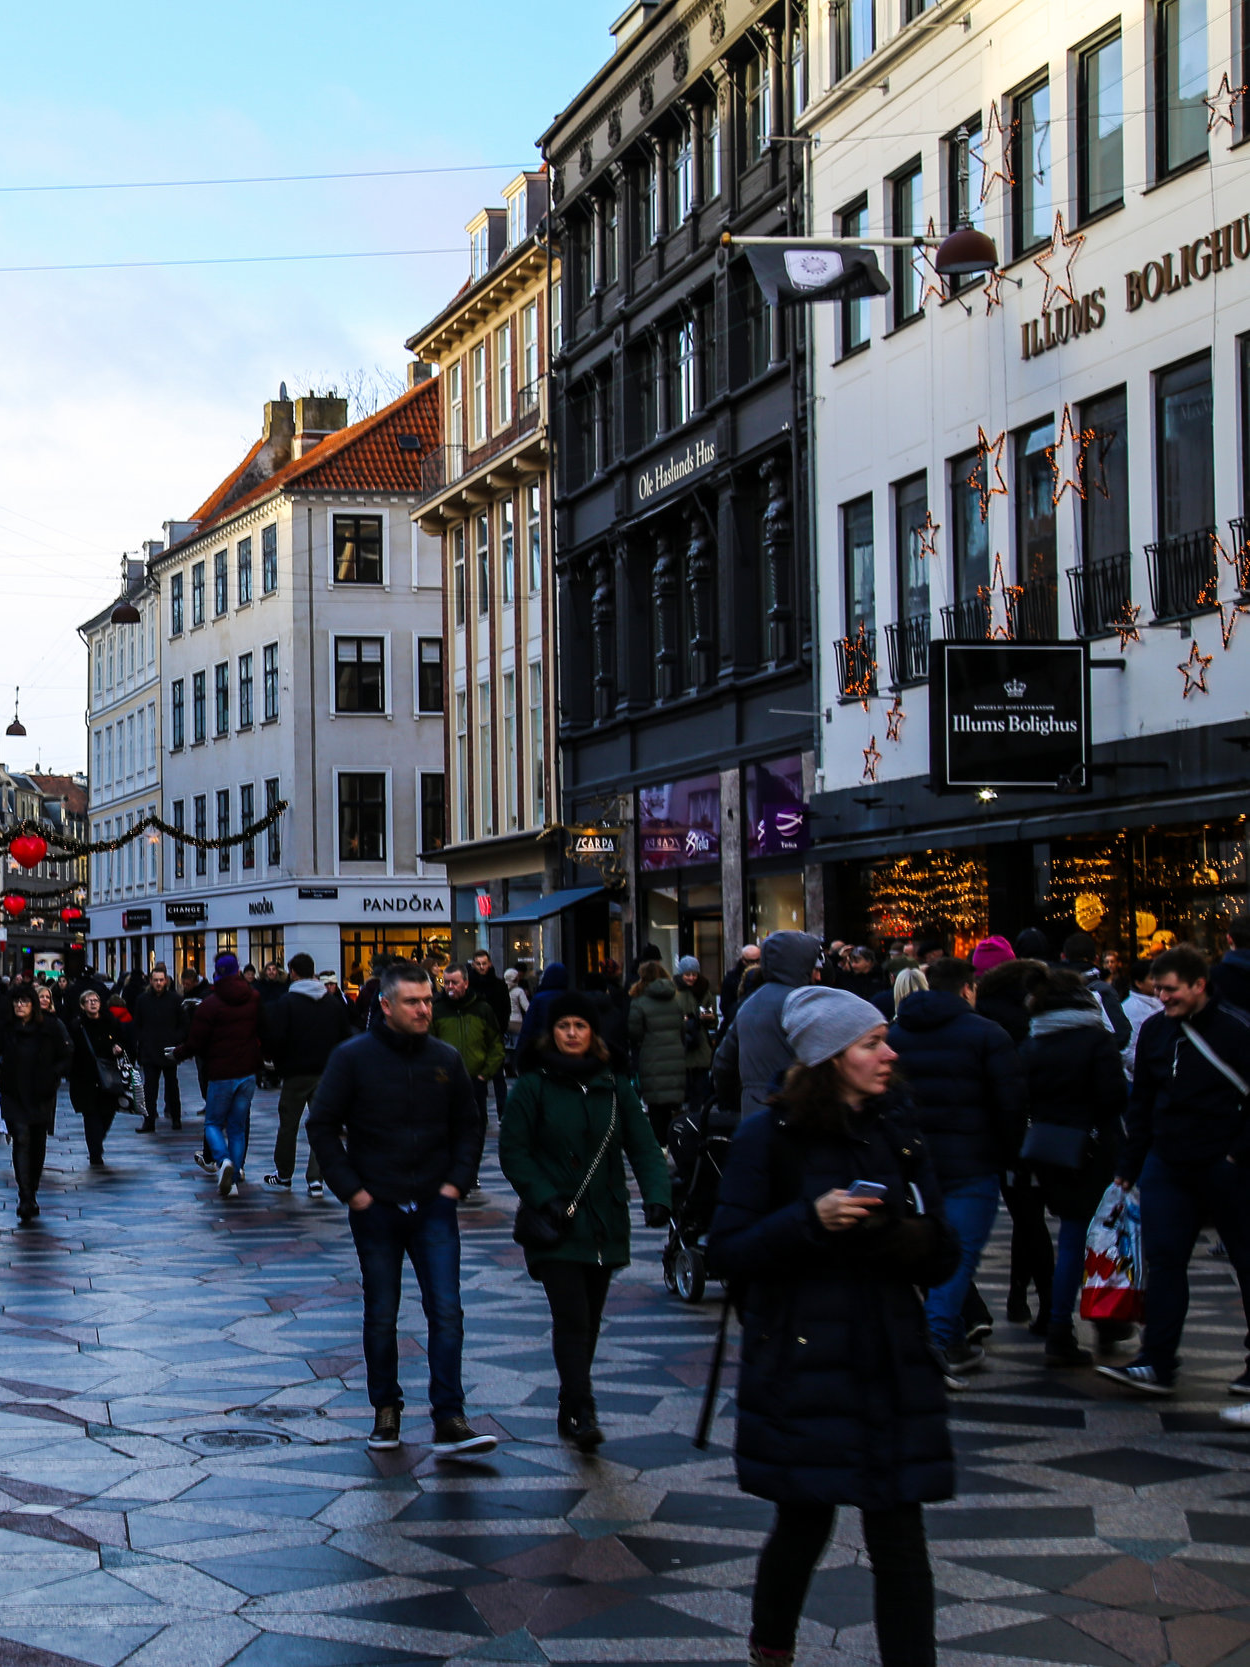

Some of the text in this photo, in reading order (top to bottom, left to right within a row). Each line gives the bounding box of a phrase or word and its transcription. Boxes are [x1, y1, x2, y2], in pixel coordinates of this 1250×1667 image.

[1020, 287, 1106, 361] ILLUMS
[638, 439, 715, 500] Ole Haslunds Hus
[953, 715, 1078, 736] Illums Bolighus
[575, 837, 614, 851] SCARPA
[167, 906, 201, 914] CHANGE
[363, 895, 445, 912] PANDORA
